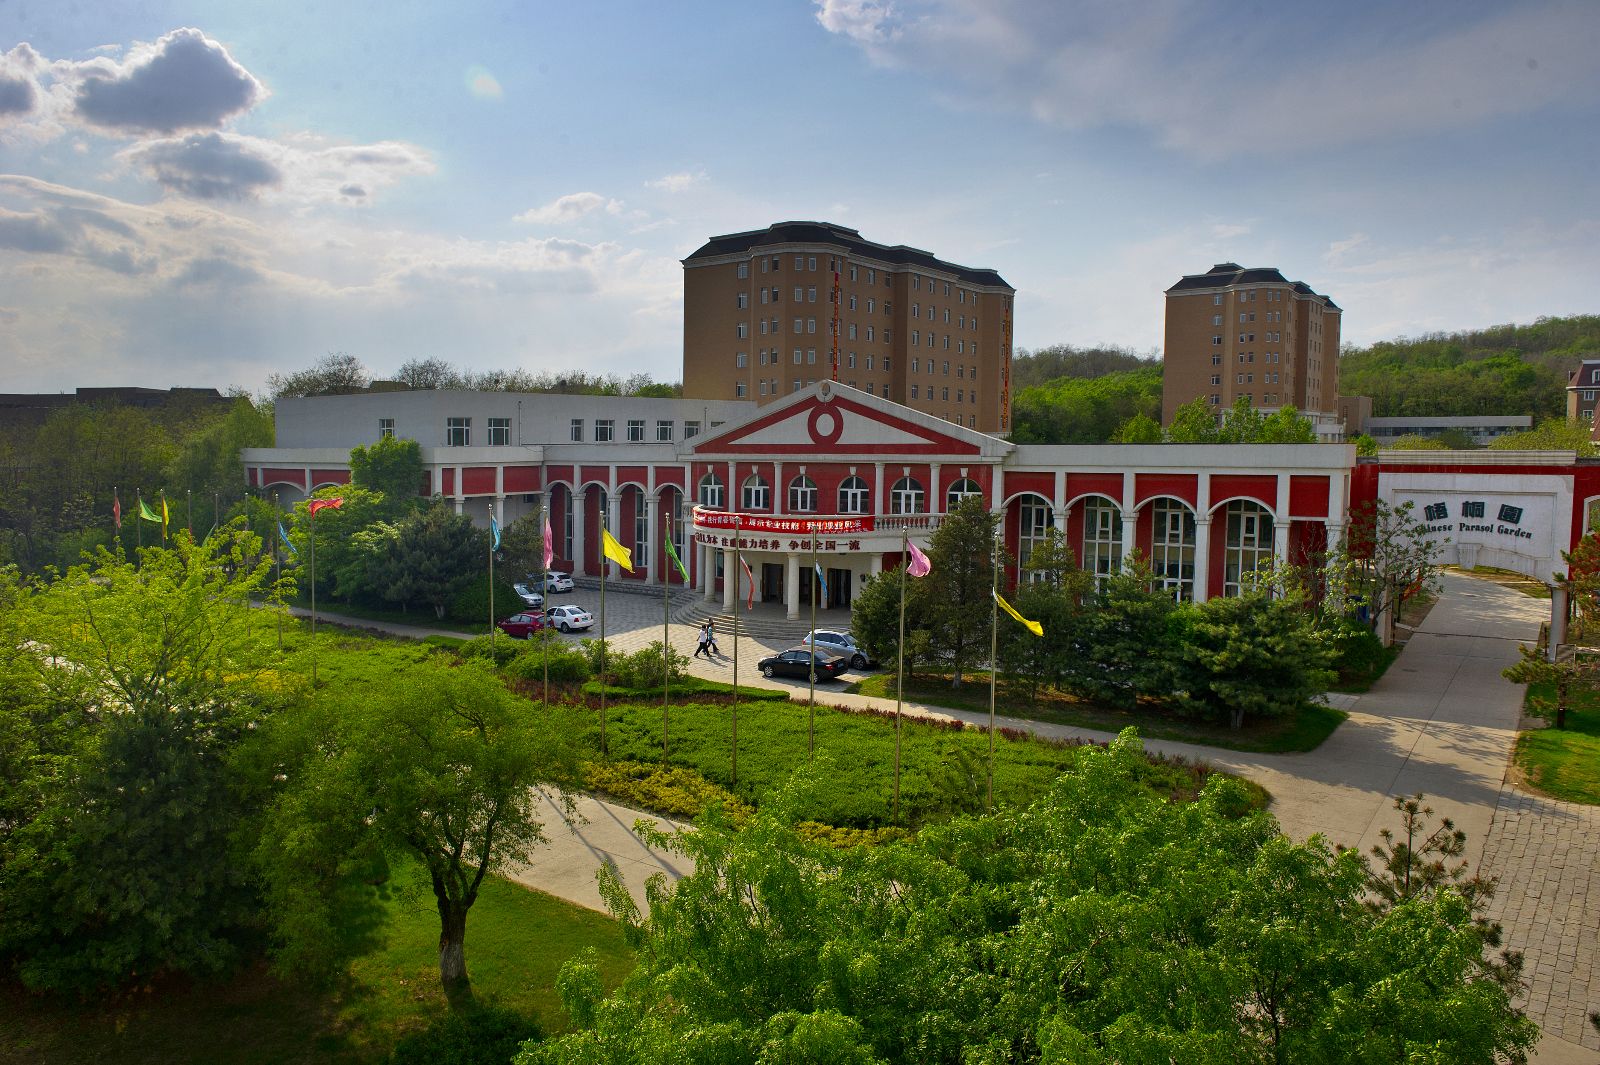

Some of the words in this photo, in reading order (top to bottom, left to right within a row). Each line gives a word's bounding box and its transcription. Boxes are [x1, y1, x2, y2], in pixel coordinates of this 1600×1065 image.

[1416, 523, 1453, 533] Cinese
[1459, 522, 1494, 533] Parasol
[1497, 525, 1533, 539] Garden
